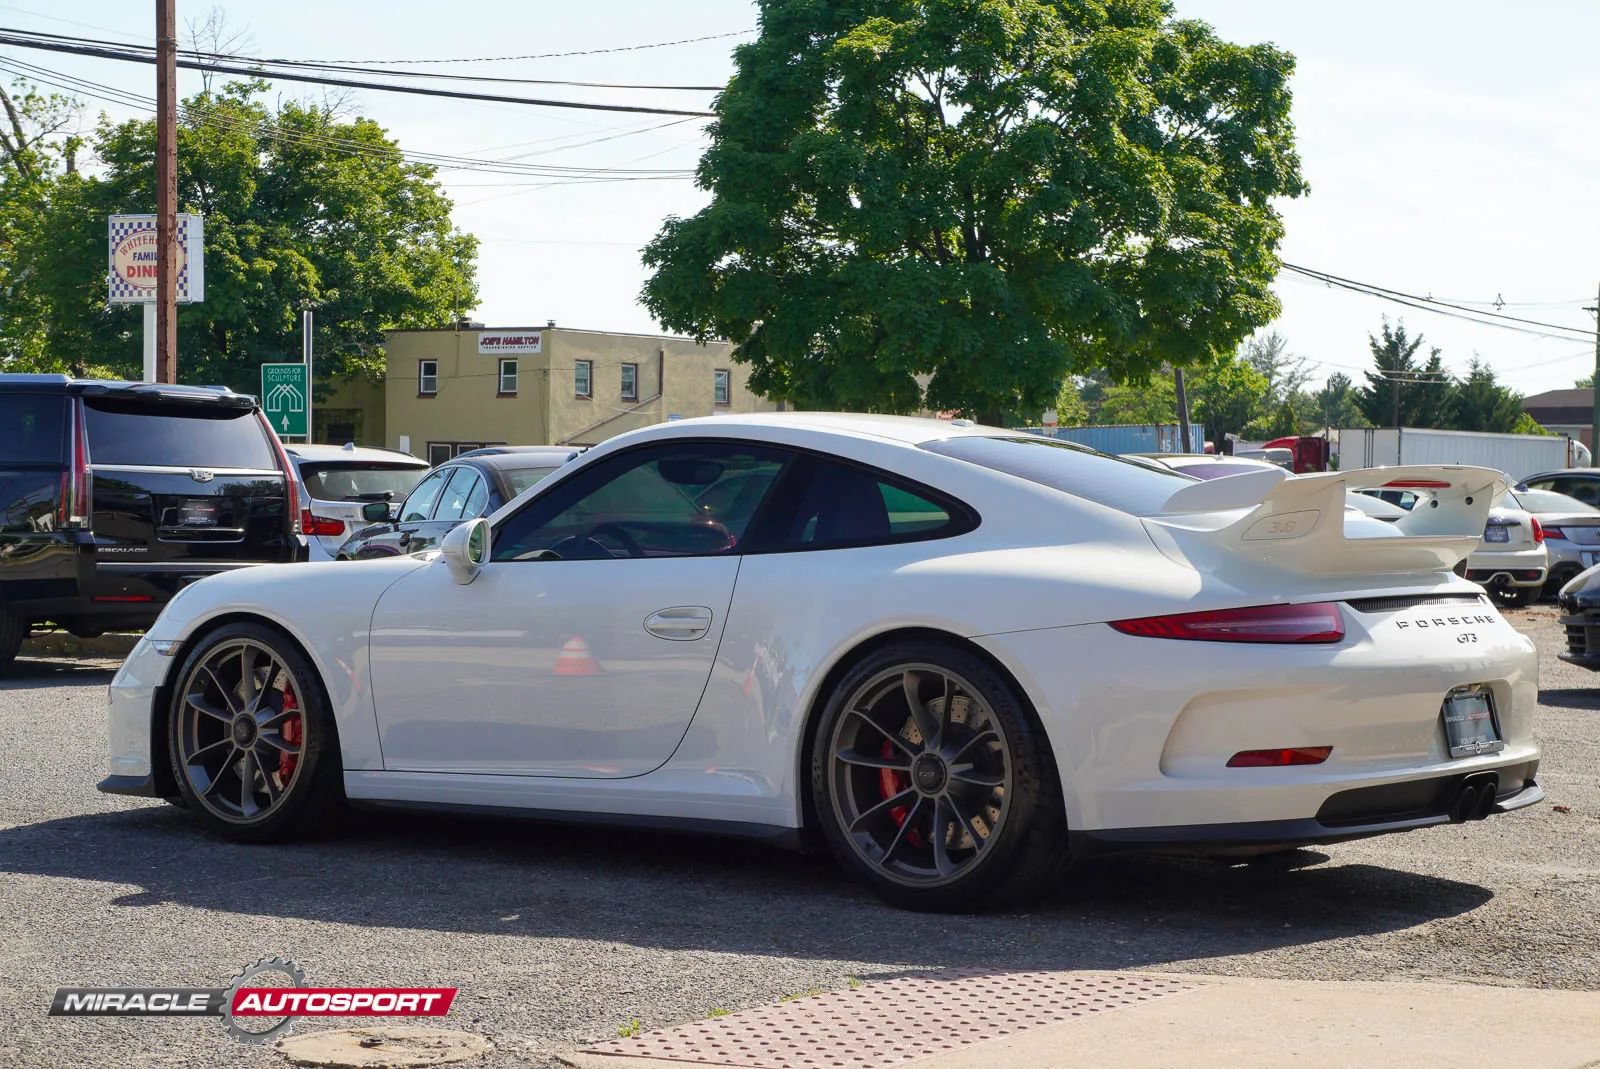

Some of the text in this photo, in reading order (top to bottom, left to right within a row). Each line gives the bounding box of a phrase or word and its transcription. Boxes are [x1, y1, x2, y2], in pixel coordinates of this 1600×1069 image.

[502, 336, 539, 345] HAMILTON
[267, 374, 301, 382] SCULPTURE
[1396, 615, 1495, 629] PORSCHE
[1456, 633, 1478, 644] GT3
